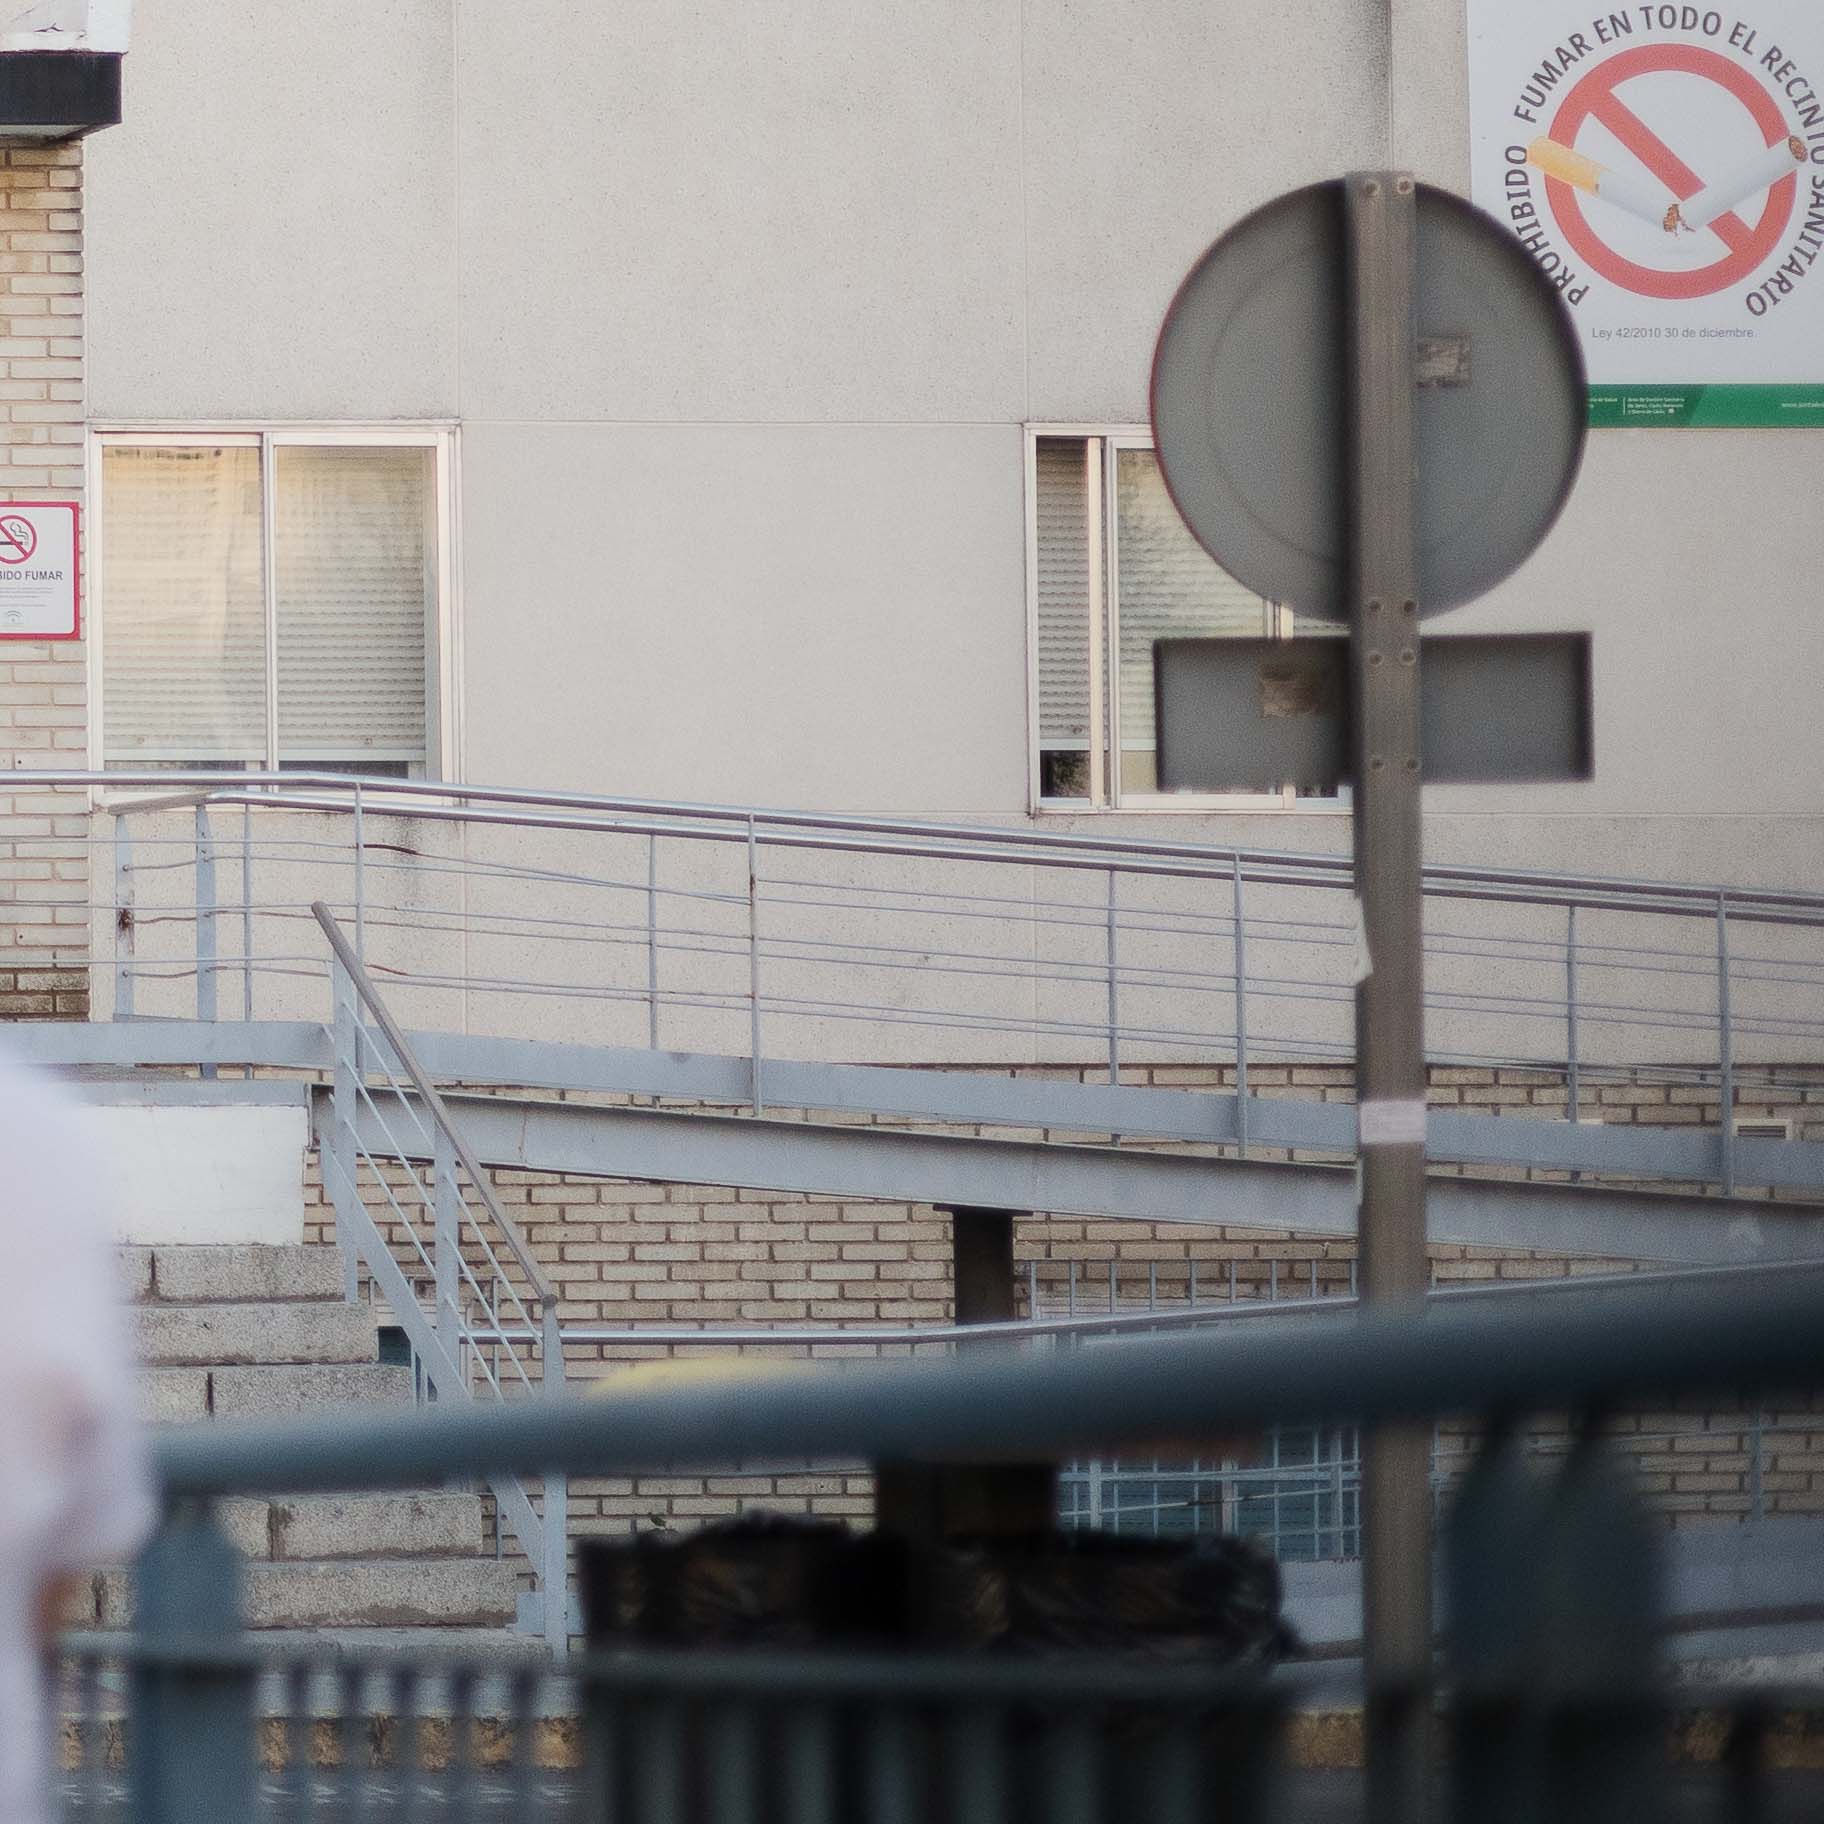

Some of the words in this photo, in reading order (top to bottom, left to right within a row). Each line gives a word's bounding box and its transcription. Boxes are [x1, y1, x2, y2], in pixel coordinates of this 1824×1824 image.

[1593, 10, 1633, 45] EN
[1639, 5, 1722, 36] TODO
[1728, 21, 1757, 56] EL
[1514, 33, 1594, 123] FUMAR
[1505, 145, 1590, 306] PROHIBIDO
[1592, 327, 1612, 341] Ley
[1616, 327, 1661, 339] 42/2010
[1664, 327, 1679, 339] 30
[1682, 327, 1696, 339] de
[25, 570, 63, 581] FUMAR
